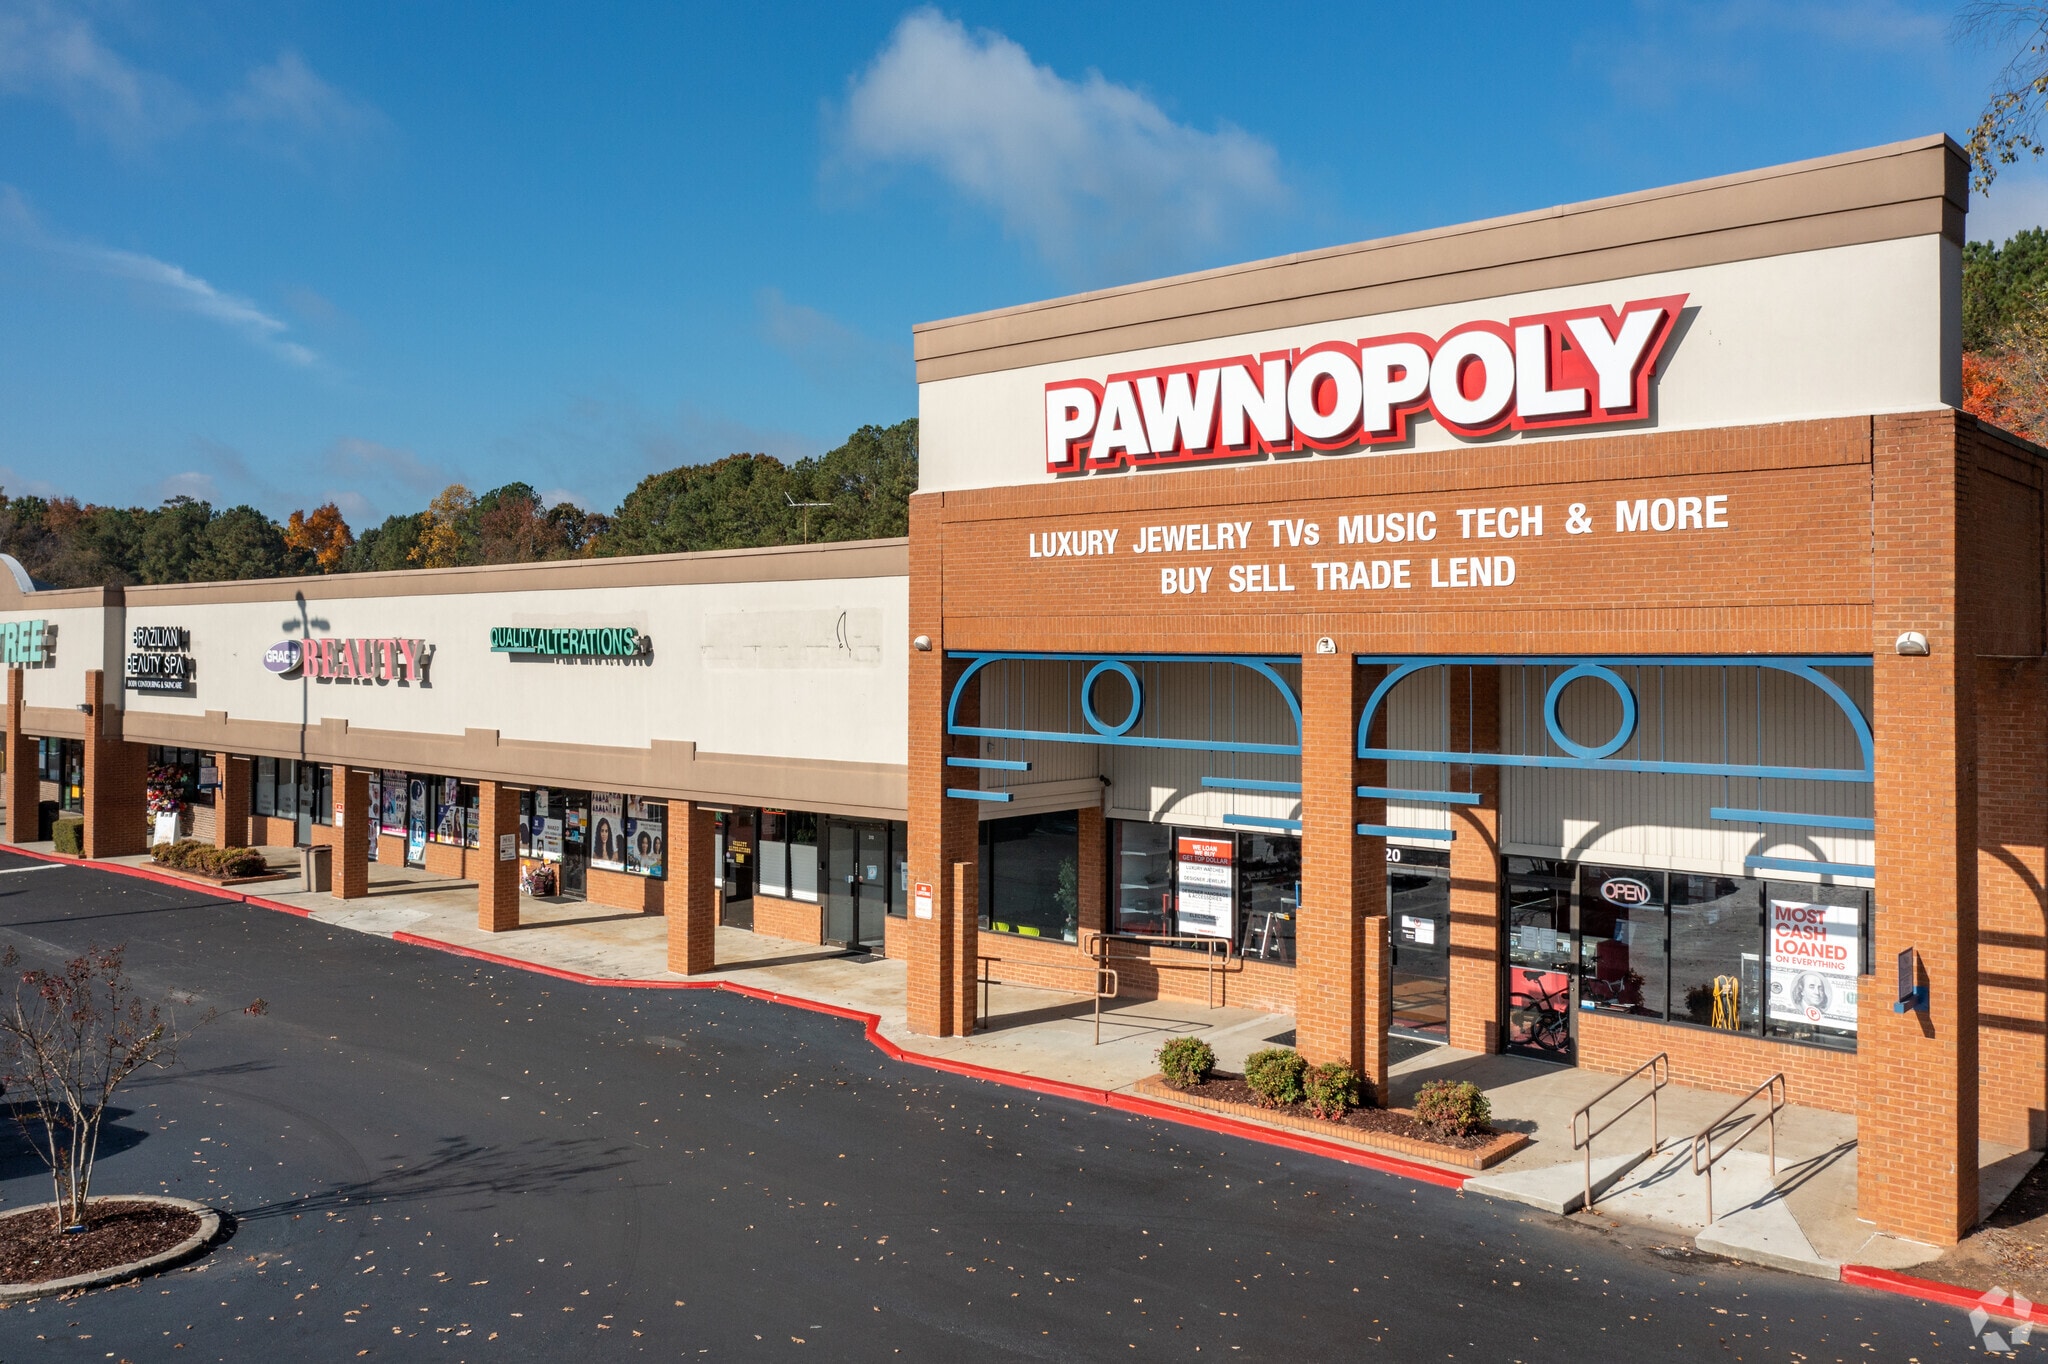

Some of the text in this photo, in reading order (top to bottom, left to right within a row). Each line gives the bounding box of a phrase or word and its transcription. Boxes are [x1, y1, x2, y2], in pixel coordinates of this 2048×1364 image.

[1046, 307, 1664, 464] PAWNOPOLY
[1029, 494, 1729, 558] LUXURY JEWELRY TVs MUSIC TECH & MORE
[1161, 556, 1516, 595] BUY SELL TRADE LEND
[133, 629, 178, 647] BRAZILIAN
[490, 627, 636, 656] QUALITY ALTERATIONS
[127, 655, 184, 674] BEAUTY SPA
[265, 649, 298, 665] GRACE
[301, 638, 425, 681] BEAUTY
[1202, 844, 1218, 852] LOAN
[1206, 856, 1228, 864] DOLLAR
[1604, 883, 1645, 901] OPEN
[1775, 906, 1826, 925] MOST
[1775, 922, 1827, 941] CASH
[1775, 939, 1847, 960] LOANED
[1775, 955, 1845, 970] ON EVERYTHING
